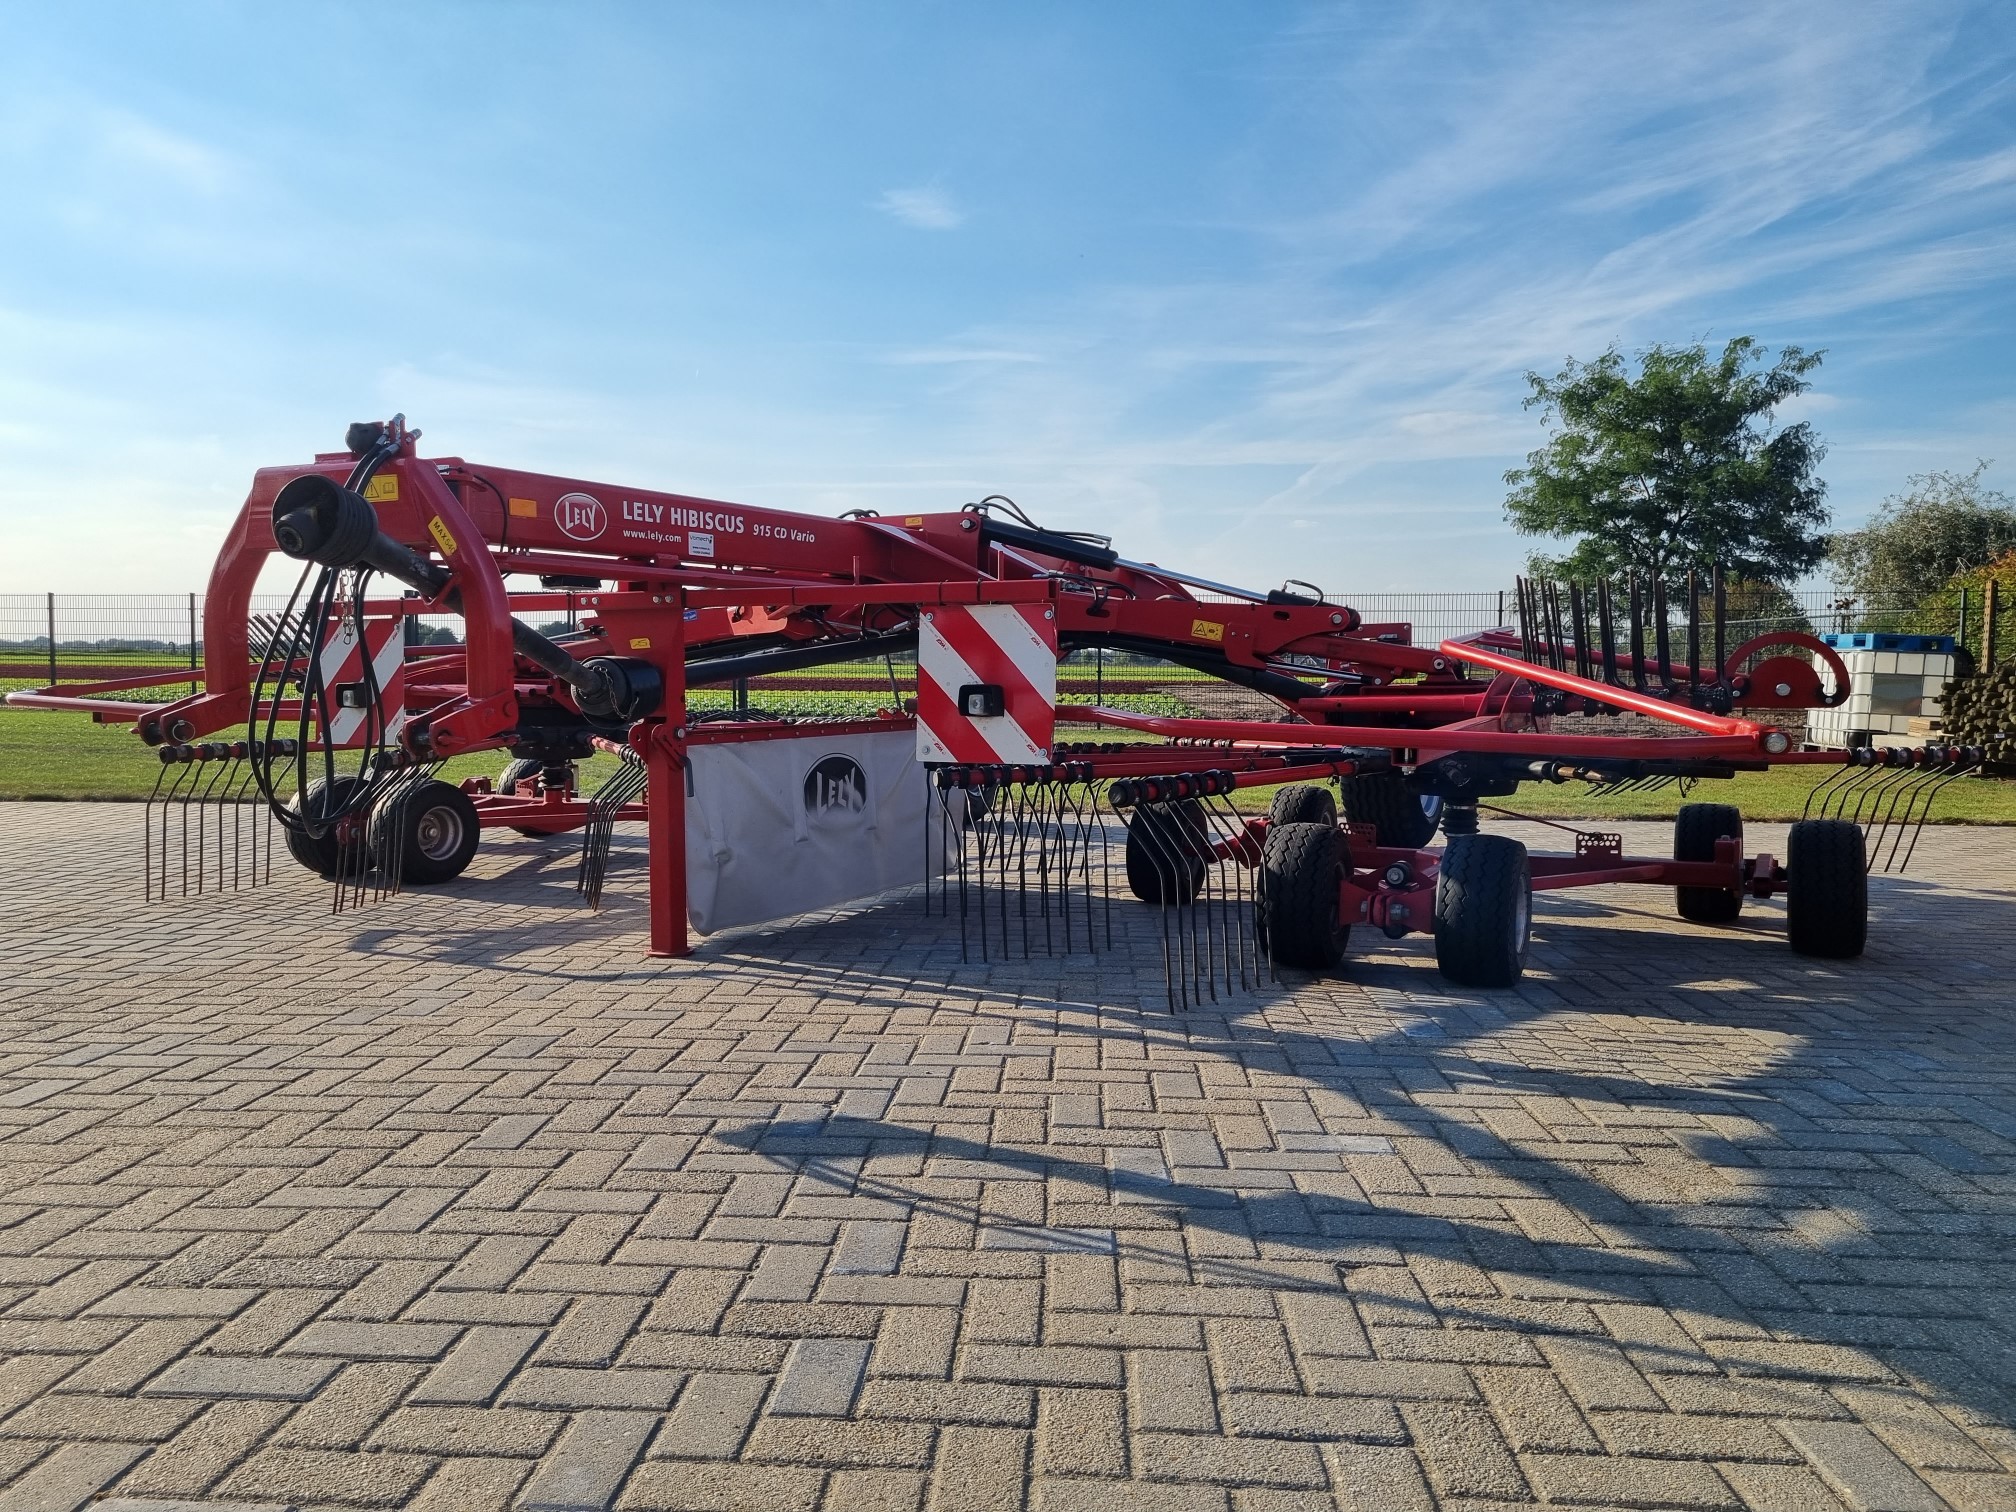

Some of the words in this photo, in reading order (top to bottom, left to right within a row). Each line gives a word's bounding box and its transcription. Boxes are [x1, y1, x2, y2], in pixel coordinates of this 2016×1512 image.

[433, 521, 447, 540] MAX
[565, 501, 596, 532] LELY
[623, 500, 664, 523] LELY
[670, 507, 745, 534] HIBISCUS
[753, 523, 771, 537] 915
[774, 526, 787, 539] CD
[790, 529, 815, 543] Vario
[623, 529, 682, 543] www.lely.com
[816, 766, 856, 815] LELY
